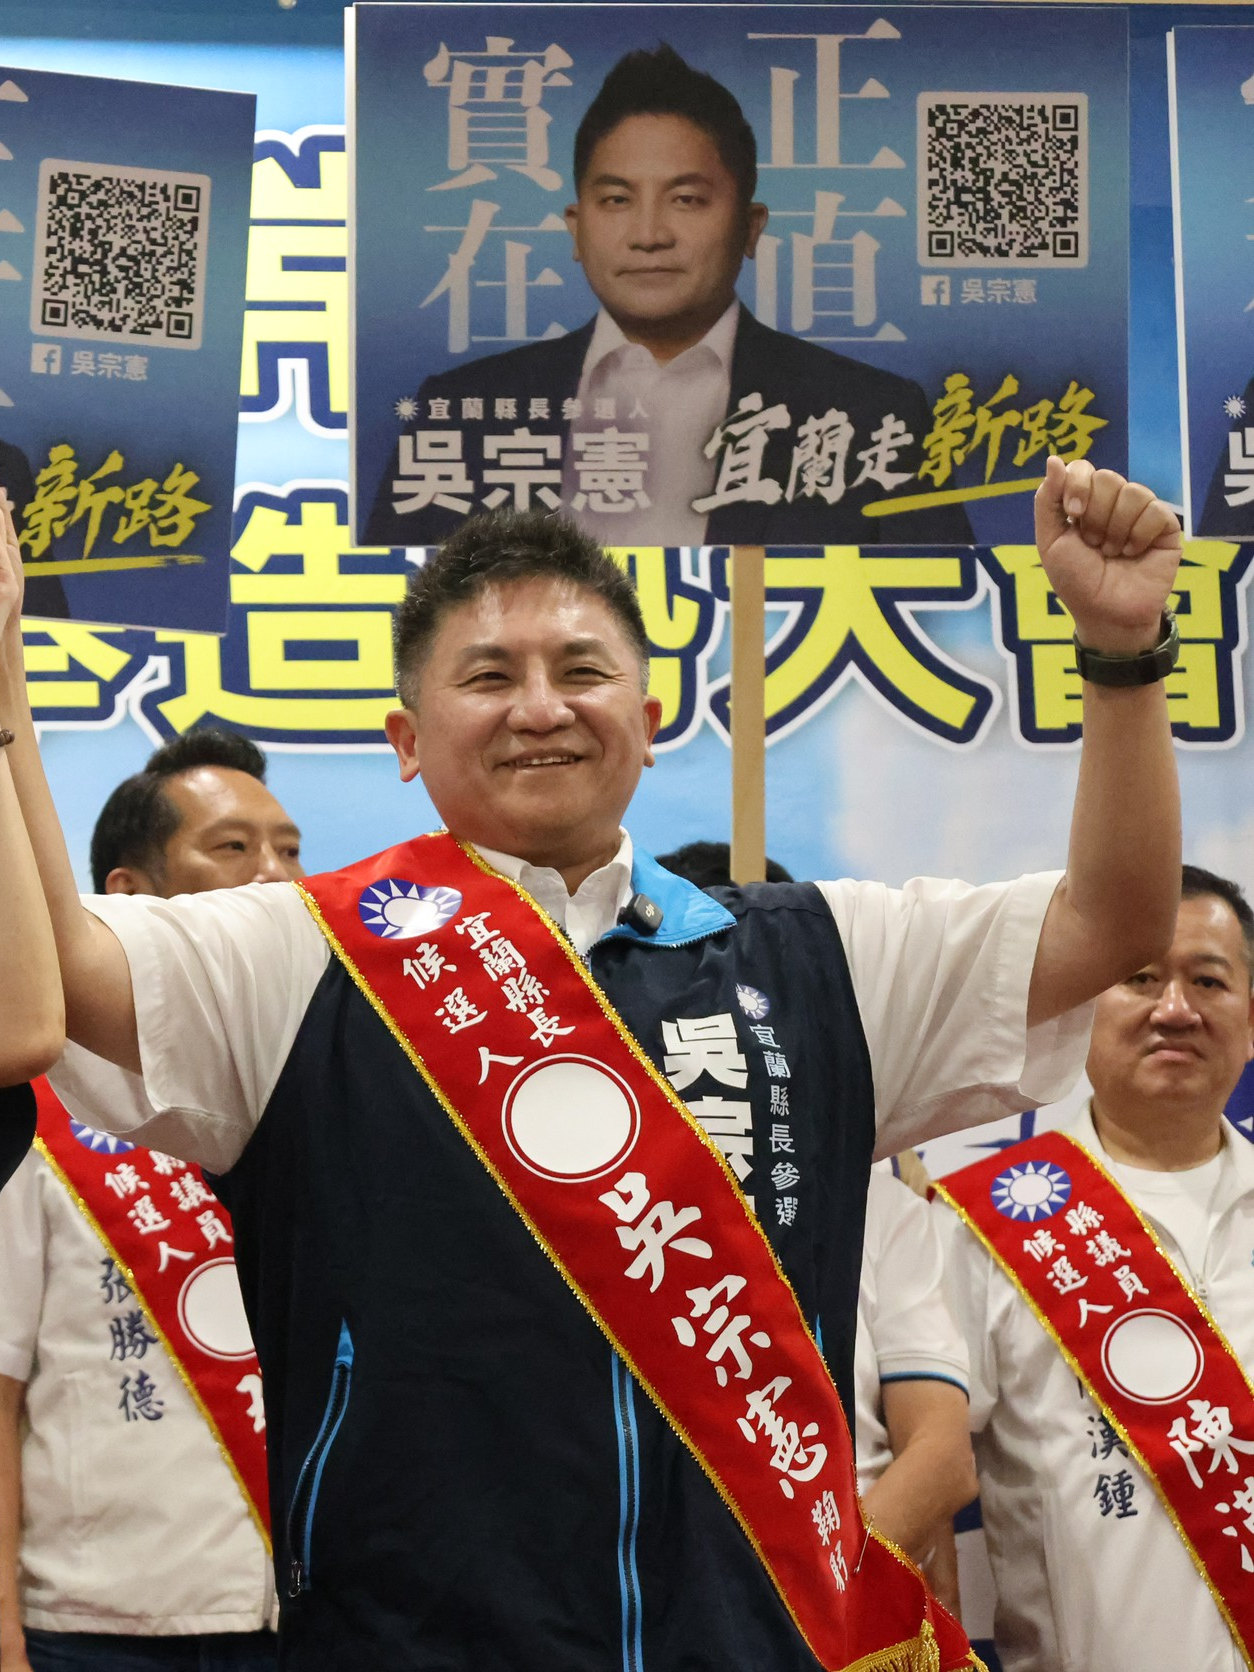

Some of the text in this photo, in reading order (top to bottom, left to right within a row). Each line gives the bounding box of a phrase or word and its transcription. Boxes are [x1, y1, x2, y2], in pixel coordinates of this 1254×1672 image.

[419, 36, 575, 354] 實在
[746, 18, 908, 345] 正直
[960, 278, 1037, 304] 吳宗憲
[71, 351, 149, 381] 吳宗憲
[428, 397, 649, 420] 宜蘭縣長參選人
[392, 426, 652, 514] 吳宗憲
[691, 373, 1109, 514] 宜蘭走新路
[402, 942, 525, 1086] 候選人
[454, 911, 577, 1048] 宜蘭縣長
[661, 1013, 756, 1215] 吳宗
[749, 1023, 801, 1264] 宜蘭縣長參選
[105, 1163, 195, 1273] 候選人
[1023, 1229, 1114, 1328] 候選人
[1064, 1201, 1150, 1303] 縣議員
[598, 1171, 827, 1499] 吳宗憲
[1077, 1377, 1139, 1519] 漢鍾
[811, 1490, 848, 1594] 鞠躬
